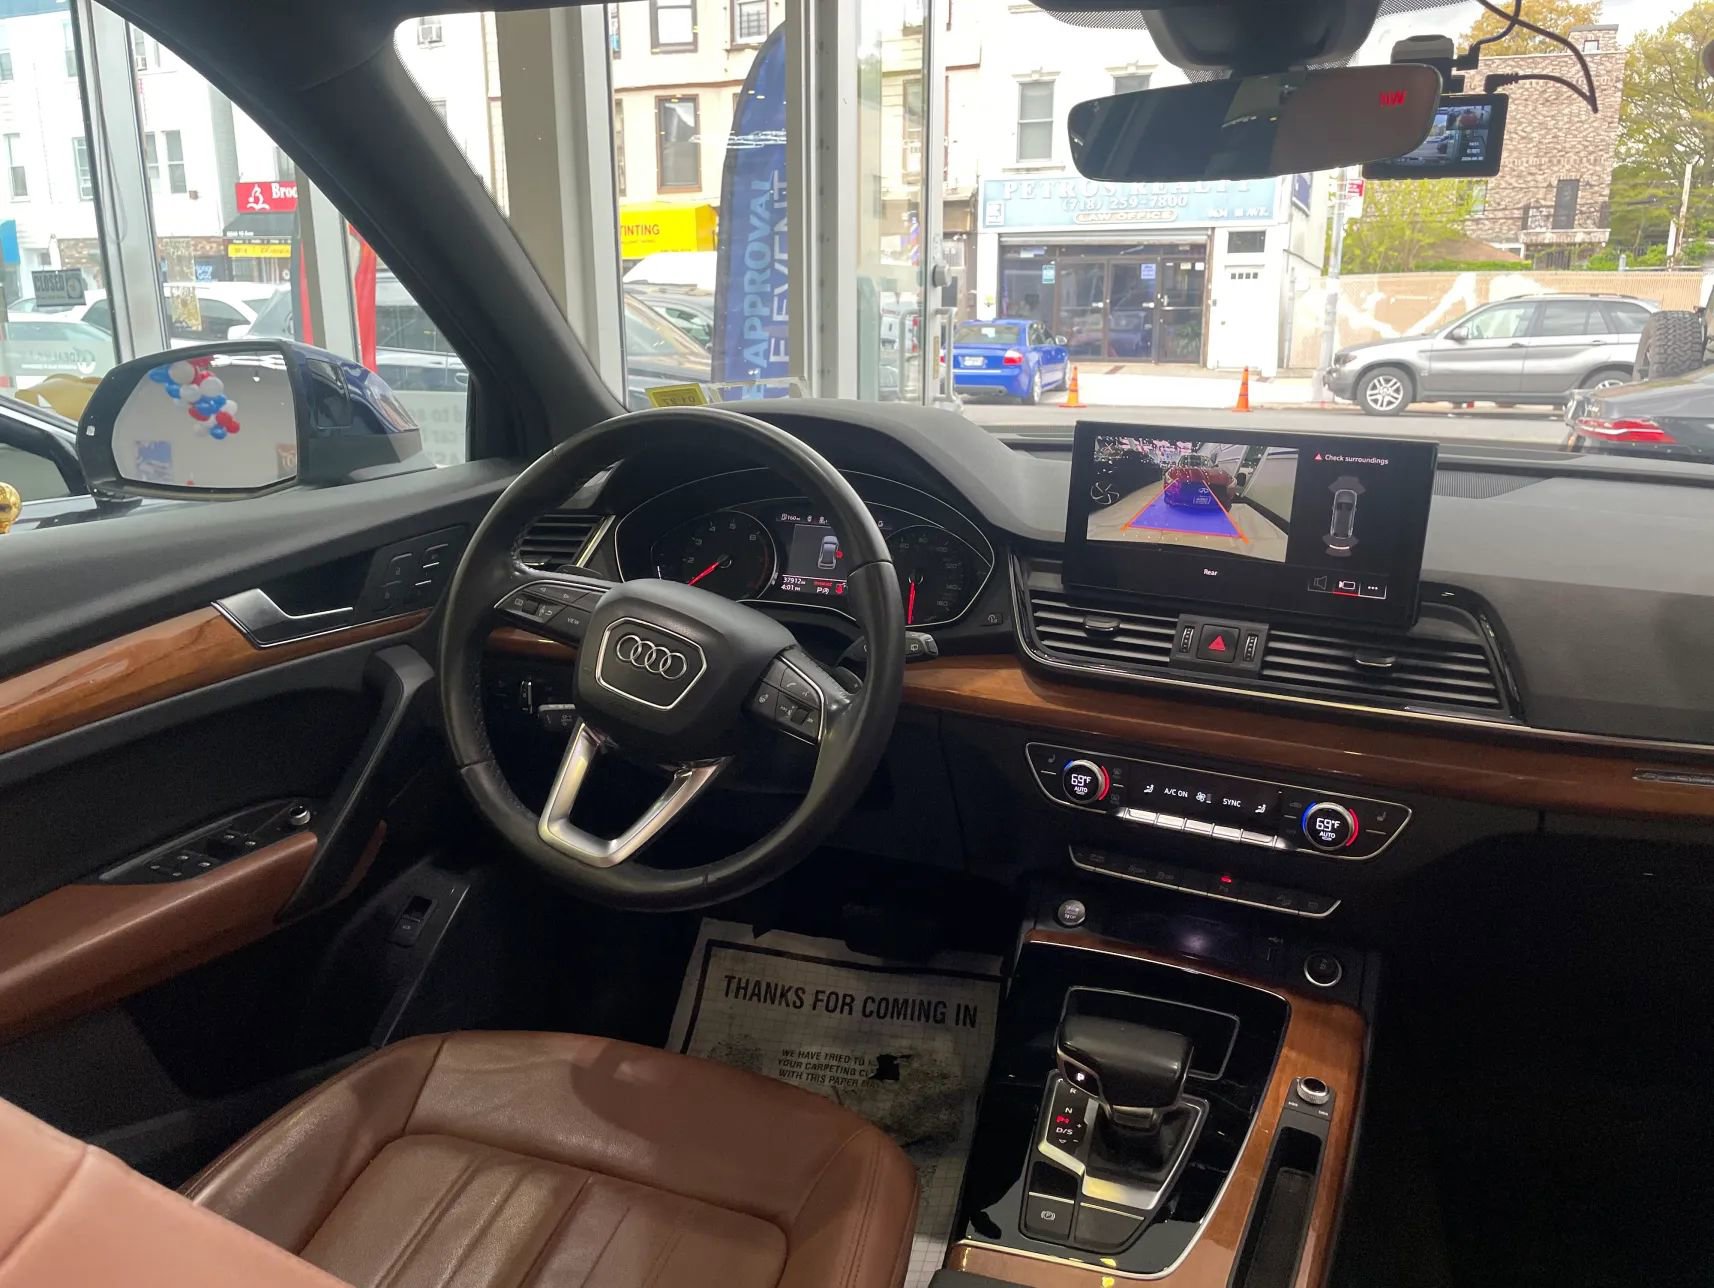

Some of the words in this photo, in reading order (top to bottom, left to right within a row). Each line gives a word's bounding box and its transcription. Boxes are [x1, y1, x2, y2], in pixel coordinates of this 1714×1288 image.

[1003, 179, 1117, 200] PETROS
[1062, 199, 1103, 212] (718)
[1110, 195, 1188, 210] 259-7800
[1078, 213, 1111, 222] LAW
[1117, 211, 1173, 220] OFFICE
[743, 171, 772, 368] APPROVAL
[1345, 456, 1389, 466] surroundings
[1203, 569, 1217, 577] Rear
[783, 576, 801, 584] 37912
[1071, 773, 1092, 787] 69°F
[1074, 786, 1088, 794] AUTO
[1164, 787, 1177, 796] A/C
[1177, 790, 1188, 798] ON
[1222, 798, 1241, 808] SYNC
[1315, 817, 1341, 832] 69°F
[1319, 831, 1336, 839] AUTO
[723, 974, 806, 1010] THANKS
[812, 989, 855, 1016] FOR
[862, 995, 948, 1026] COMING
[954, 1003, 978, 1029] IN
[782, 1049, 795, 1057] WE
[798, 1050, 821, 1061] HAVE
[825, 1052, 850, 1063] TRIED
[854, 1056, 865, 1066] TO
[777, 1059, 803, 1070] YOUR
[805, 1062, 856, 1076] CARPETING
[778, 1069, 802, 1080] WITH
[805, 1073, 826, 1084] THIS
[828, 1075, 858, 1087] PAPER
[1076, 1073, 1085, 1082] P
[1056, 1127, 1073, 1135] D/S
